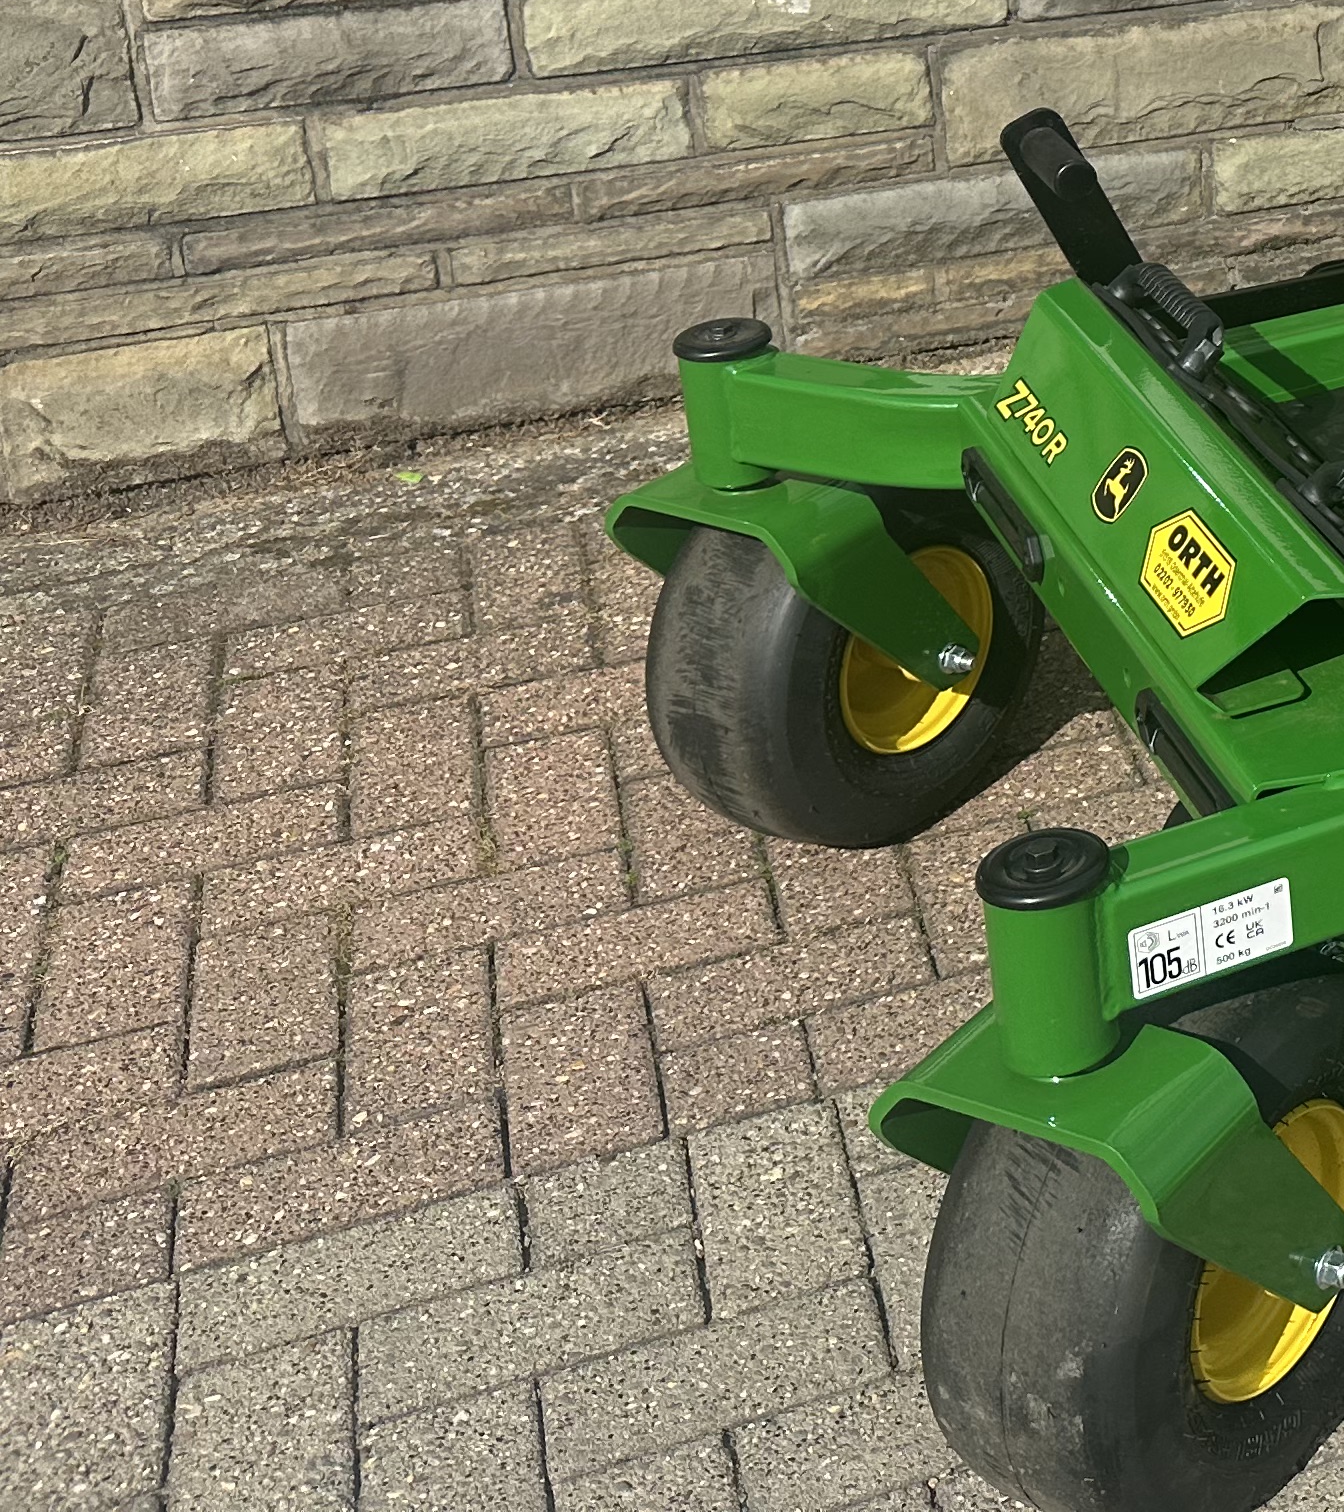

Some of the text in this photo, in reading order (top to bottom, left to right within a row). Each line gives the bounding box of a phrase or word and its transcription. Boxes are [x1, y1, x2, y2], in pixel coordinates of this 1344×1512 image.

[995, 378, 1069, 465] Z740R
[1168, 524, 1226, 599] ORTH
[1237, 894, 1254, 907] kW
[1212, 913, 1239, 929] 3200
[1216, 947, 1251, 965] 500 kg
